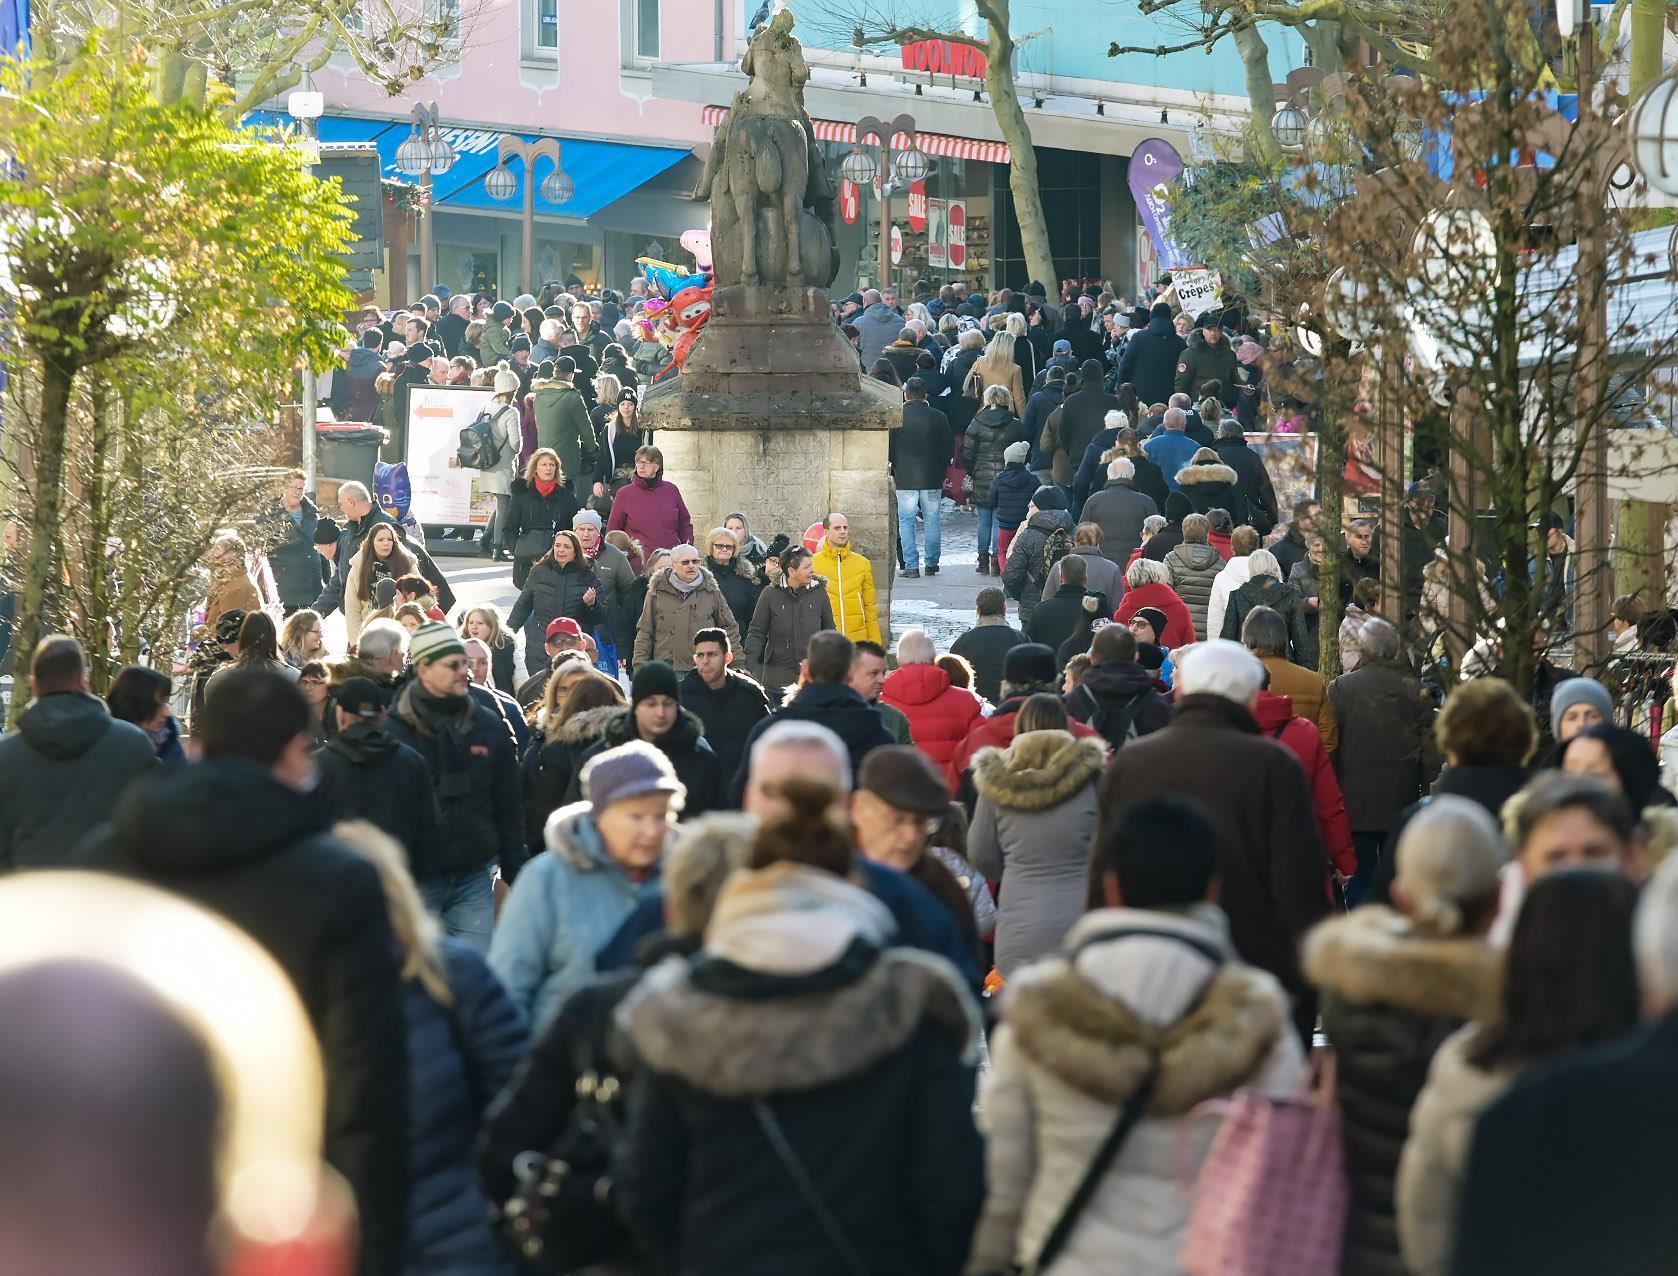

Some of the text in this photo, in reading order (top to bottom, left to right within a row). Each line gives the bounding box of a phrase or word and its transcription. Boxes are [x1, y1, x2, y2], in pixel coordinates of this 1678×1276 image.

[908, 192, 926, 219] SALE
[948, 224, 965, 246] SALE
[1178, 281, 1216, 300] Crêpes
